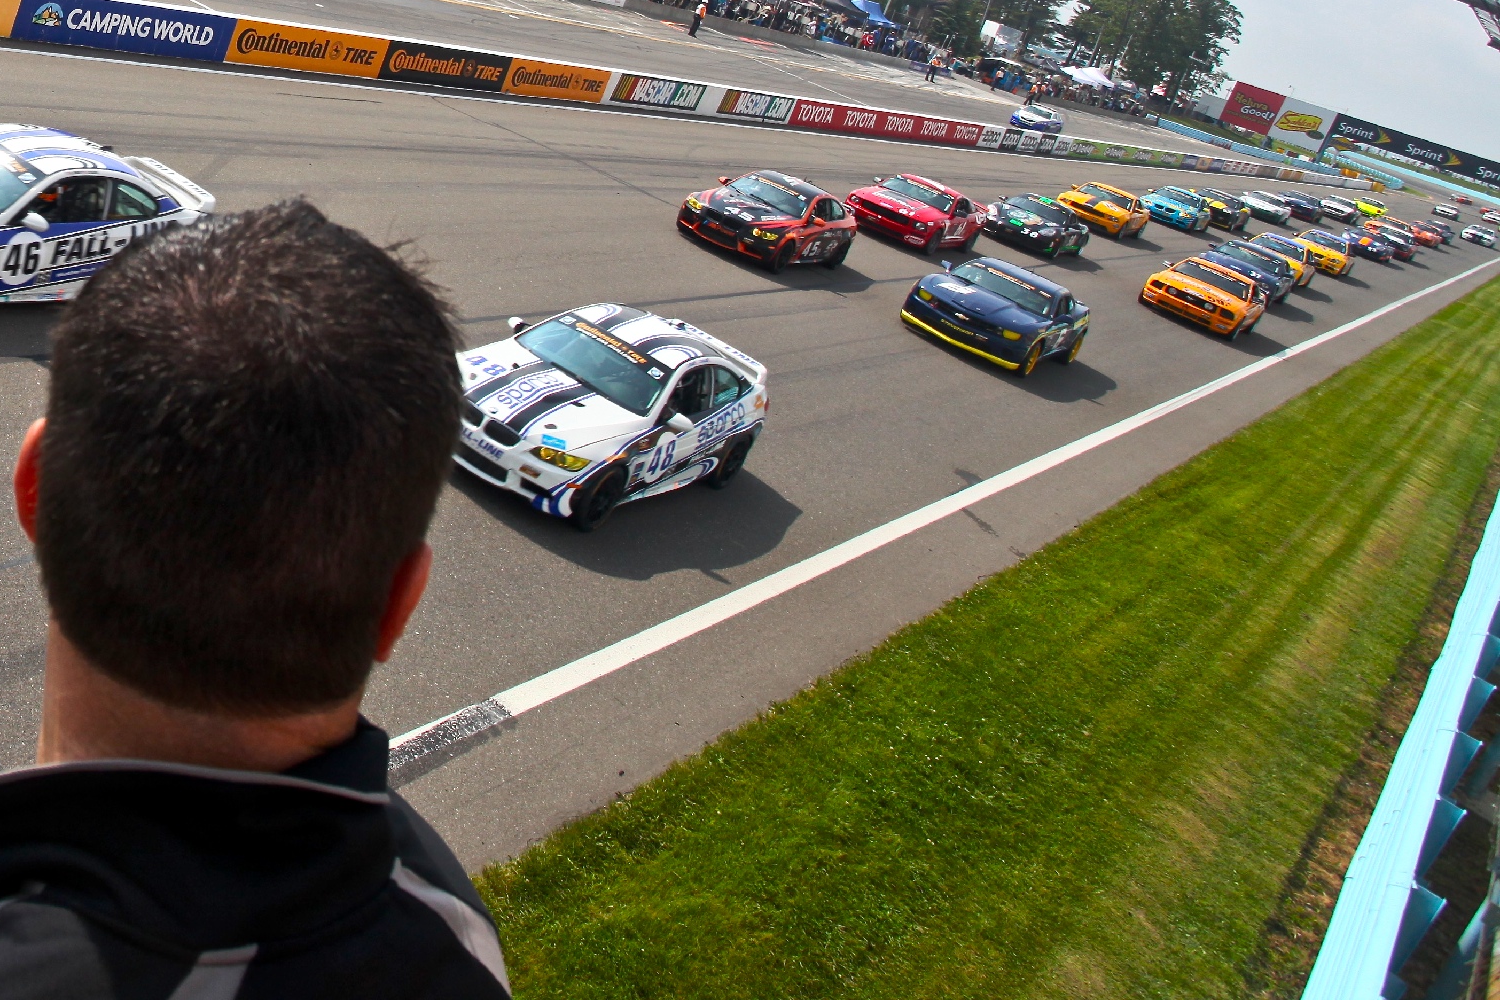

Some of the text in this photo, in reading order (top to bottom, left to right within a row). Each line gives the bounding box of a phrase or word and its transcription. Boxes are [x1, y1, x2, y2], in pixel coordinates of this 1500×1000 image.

[66, 7, 214, 46] CAMPING WORLD
[236, 28, 378, 67] Continental TIRE
[389, 49, 503, 82] Continental TIRE
[511, 66, 604, 93] Continental TIRE
[797, 104, 835, 123] TOYOTA
[846, 111, 877, 129] TOYOTA
[884, 115, 914, 133] TOYOTA
[1241, 106, 1275, 121] Good!
[921, 120, 949, 137] TOYOTA
[953, 125, 979, 141] TOYOTA
[1338, 122, 1375, 141] Sprint
[1405, 143, 1444, 162] Sprint
[2, 242, 39, 277] 46
[497, 374, 559, 405] sparco
[697, 402, 746, 443] sparco
[646, 440, 677, 476] 48
